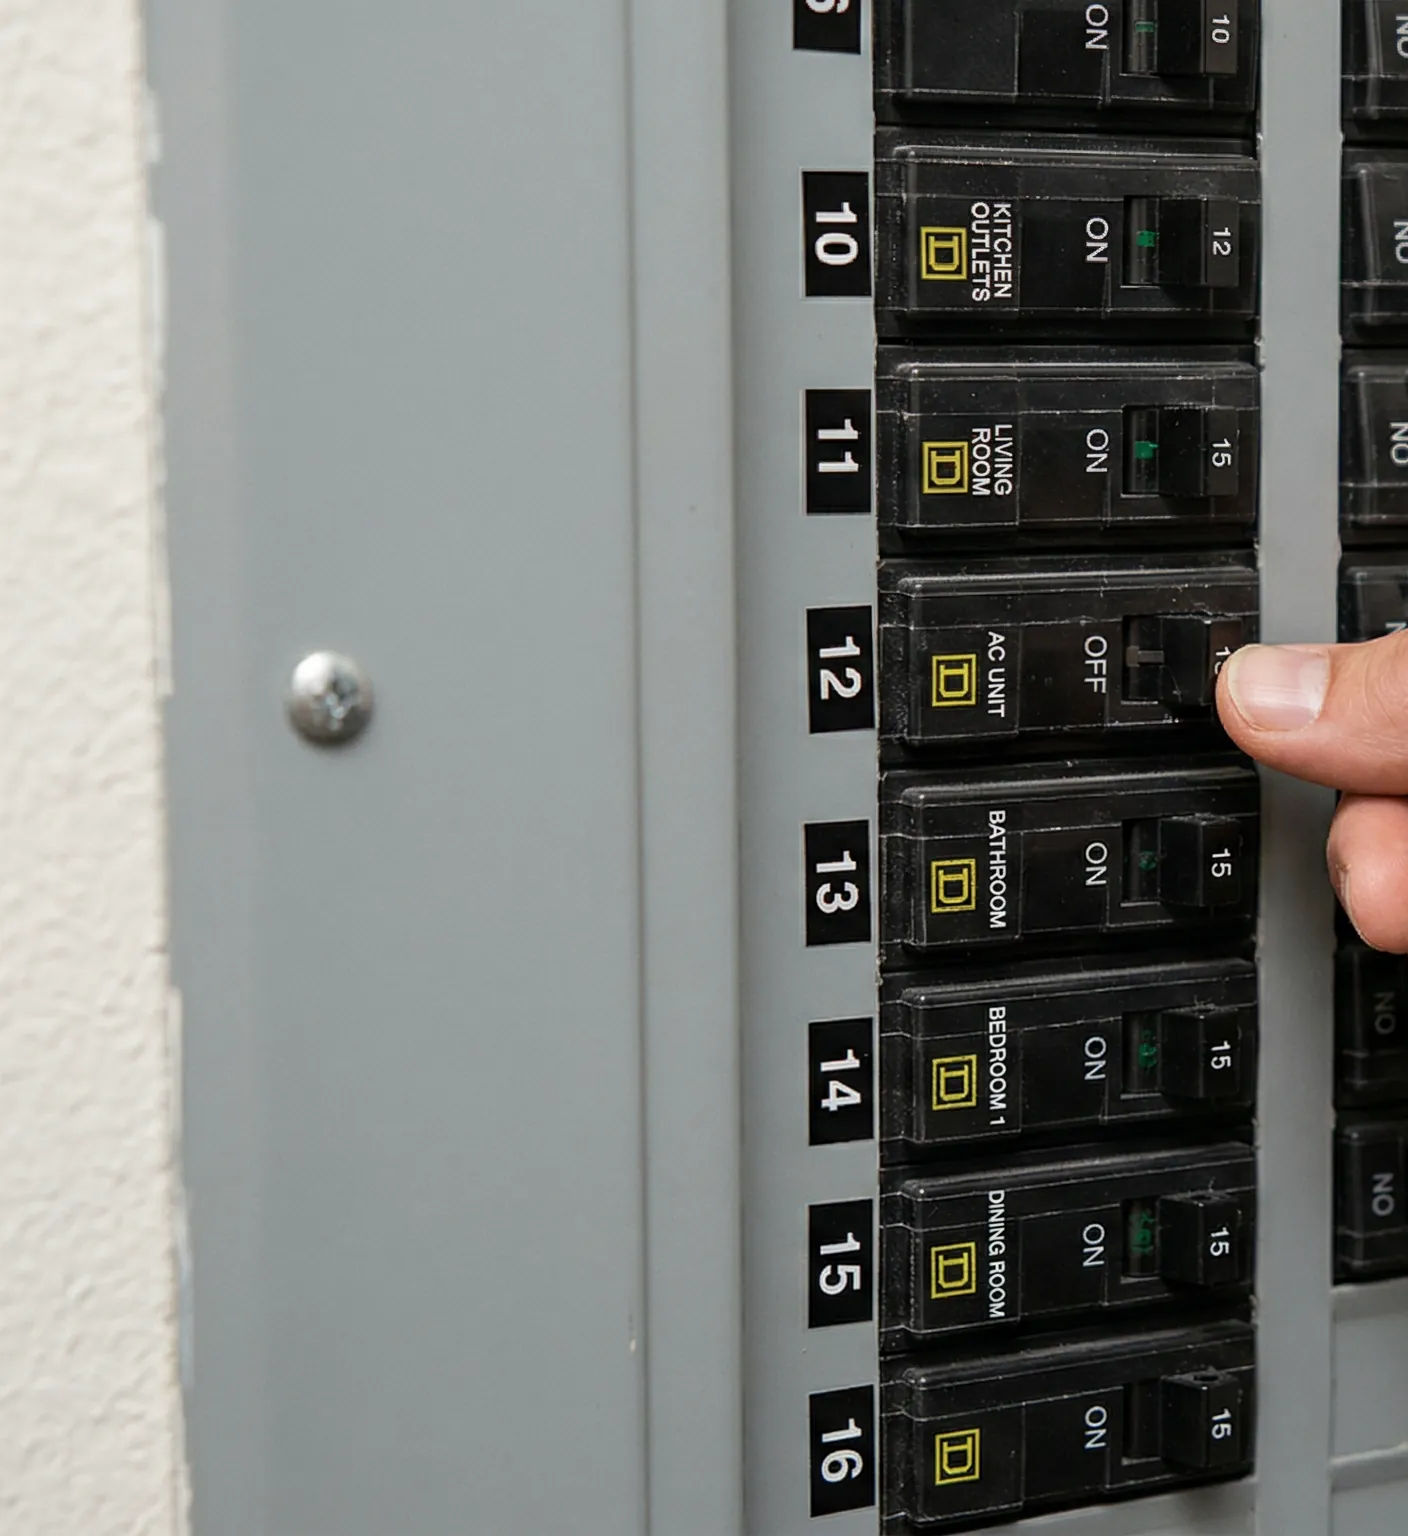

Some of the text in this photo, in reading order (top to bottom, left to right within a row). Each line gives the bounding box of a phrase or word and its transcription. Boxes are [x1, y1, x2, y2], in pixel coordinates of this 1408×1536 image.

[1085, 3, 1109, 50] ON
[1211, 14, 1230, 44] 10
[815, 201, 859, 266] 10
[971, 201, 991, 302] OUTLETS
[993, 203, 1012, 298] KITCHEN
[1086, 217, 1109, 262] ON
[1212, 227, 1231, 256] 12
[817, 418, 859, 473] 11
[971, 428, 991, 496] ROOM
[994, 424, 1013, 496] LIVING
[1085, 428, 1108, 473] ON
[1212, 438, 1232, 467] 15
[819, 636, 862, 700] 12
[987, 631, 1006, 718] AC UNIT
[1084, 635, 1108, 693] OFF
[816, 850, 859, 914] 13
[988, 810, 1007, 929] BATHROOM
[1085, 842, 1108, 886] ON
[1211, 848, 1232, 878] 15
[1374, 991, 1396, 1035] ON
[820, 1049, 862, 1112] 14
[988, 1006, 1007, 1126] BEDROOM 1
[1084, 1036, 1107, 1080] ON
[1210, 1040, 1231, 1070] 15
[1372, 1172, 1395, 1217] ON
[819, 1232, 861, 1295] 15
[988, 1189, 1006, 1318] DINING ROOM
[1082, 1223, 1105, 1267] ON
[1210, 1227, 1230, 1257] 15
[1084, 1405, 1107, 1449] ON
[1211, 1409, 1232, 1439] 15
[821, 1418, 863, 1483] 16
